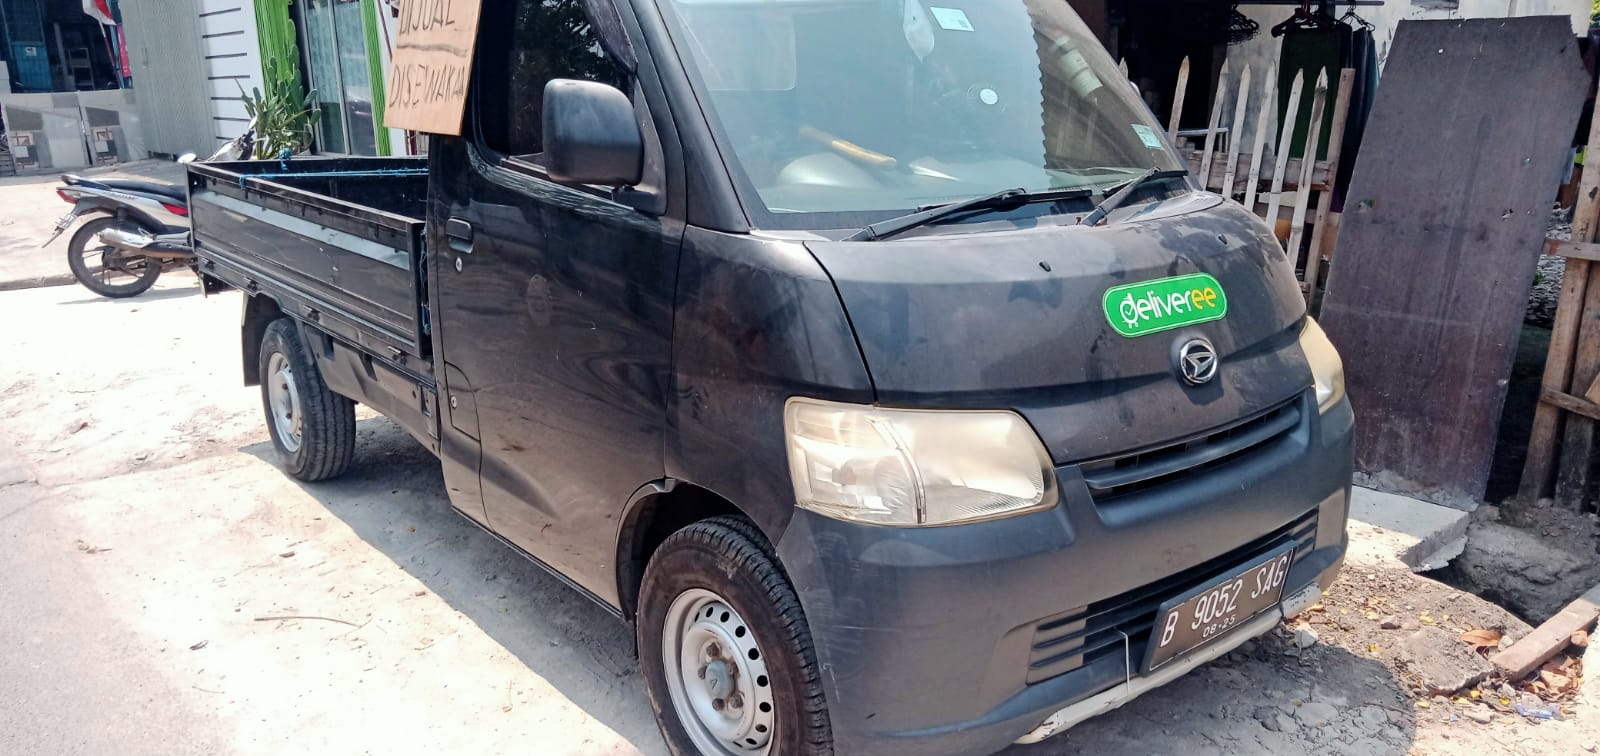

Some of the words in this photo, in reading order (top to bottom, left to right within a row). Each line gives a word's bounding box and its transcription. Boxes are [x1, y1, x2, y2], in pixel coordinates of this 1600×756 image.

[1119, 287, 1217, 328] deliveree
[1160, 611, 1179, 648] B
[1191, 578, 1243, 630] 9052
[1251, 556, 1287, 599] SAG
